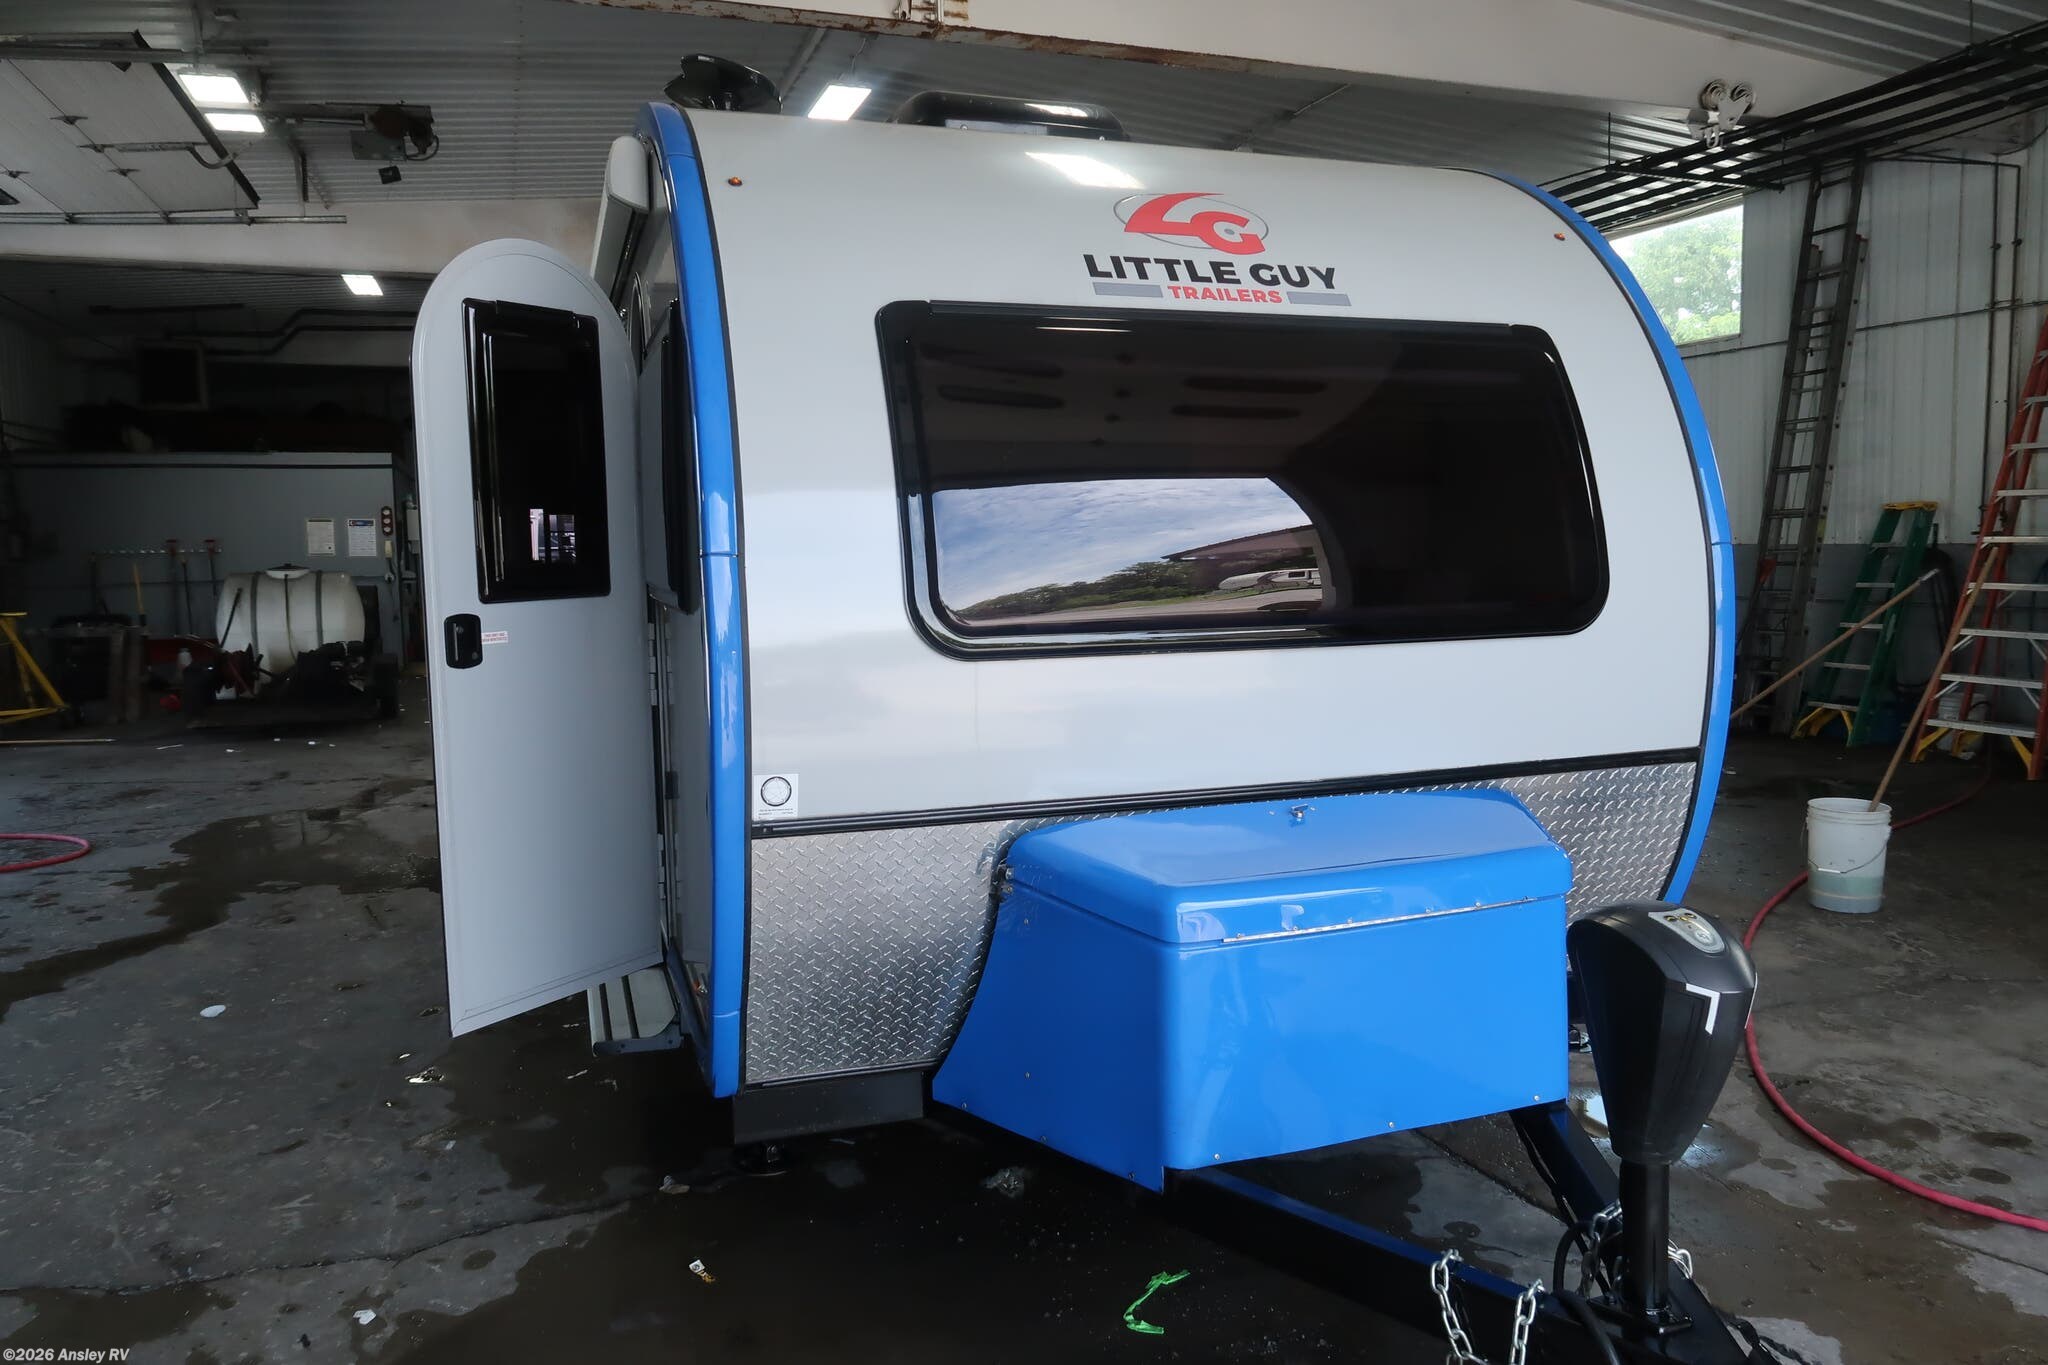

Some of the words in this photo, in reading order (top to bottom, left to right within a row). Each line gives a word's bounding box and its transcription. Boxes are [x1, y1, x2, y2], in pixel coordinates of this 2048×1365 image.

[1083, 253, 1242, 285] LITTLE
[1249, 262, 1336, 290] GUY
[1167, 285, 1283, 304] TRAILERS
